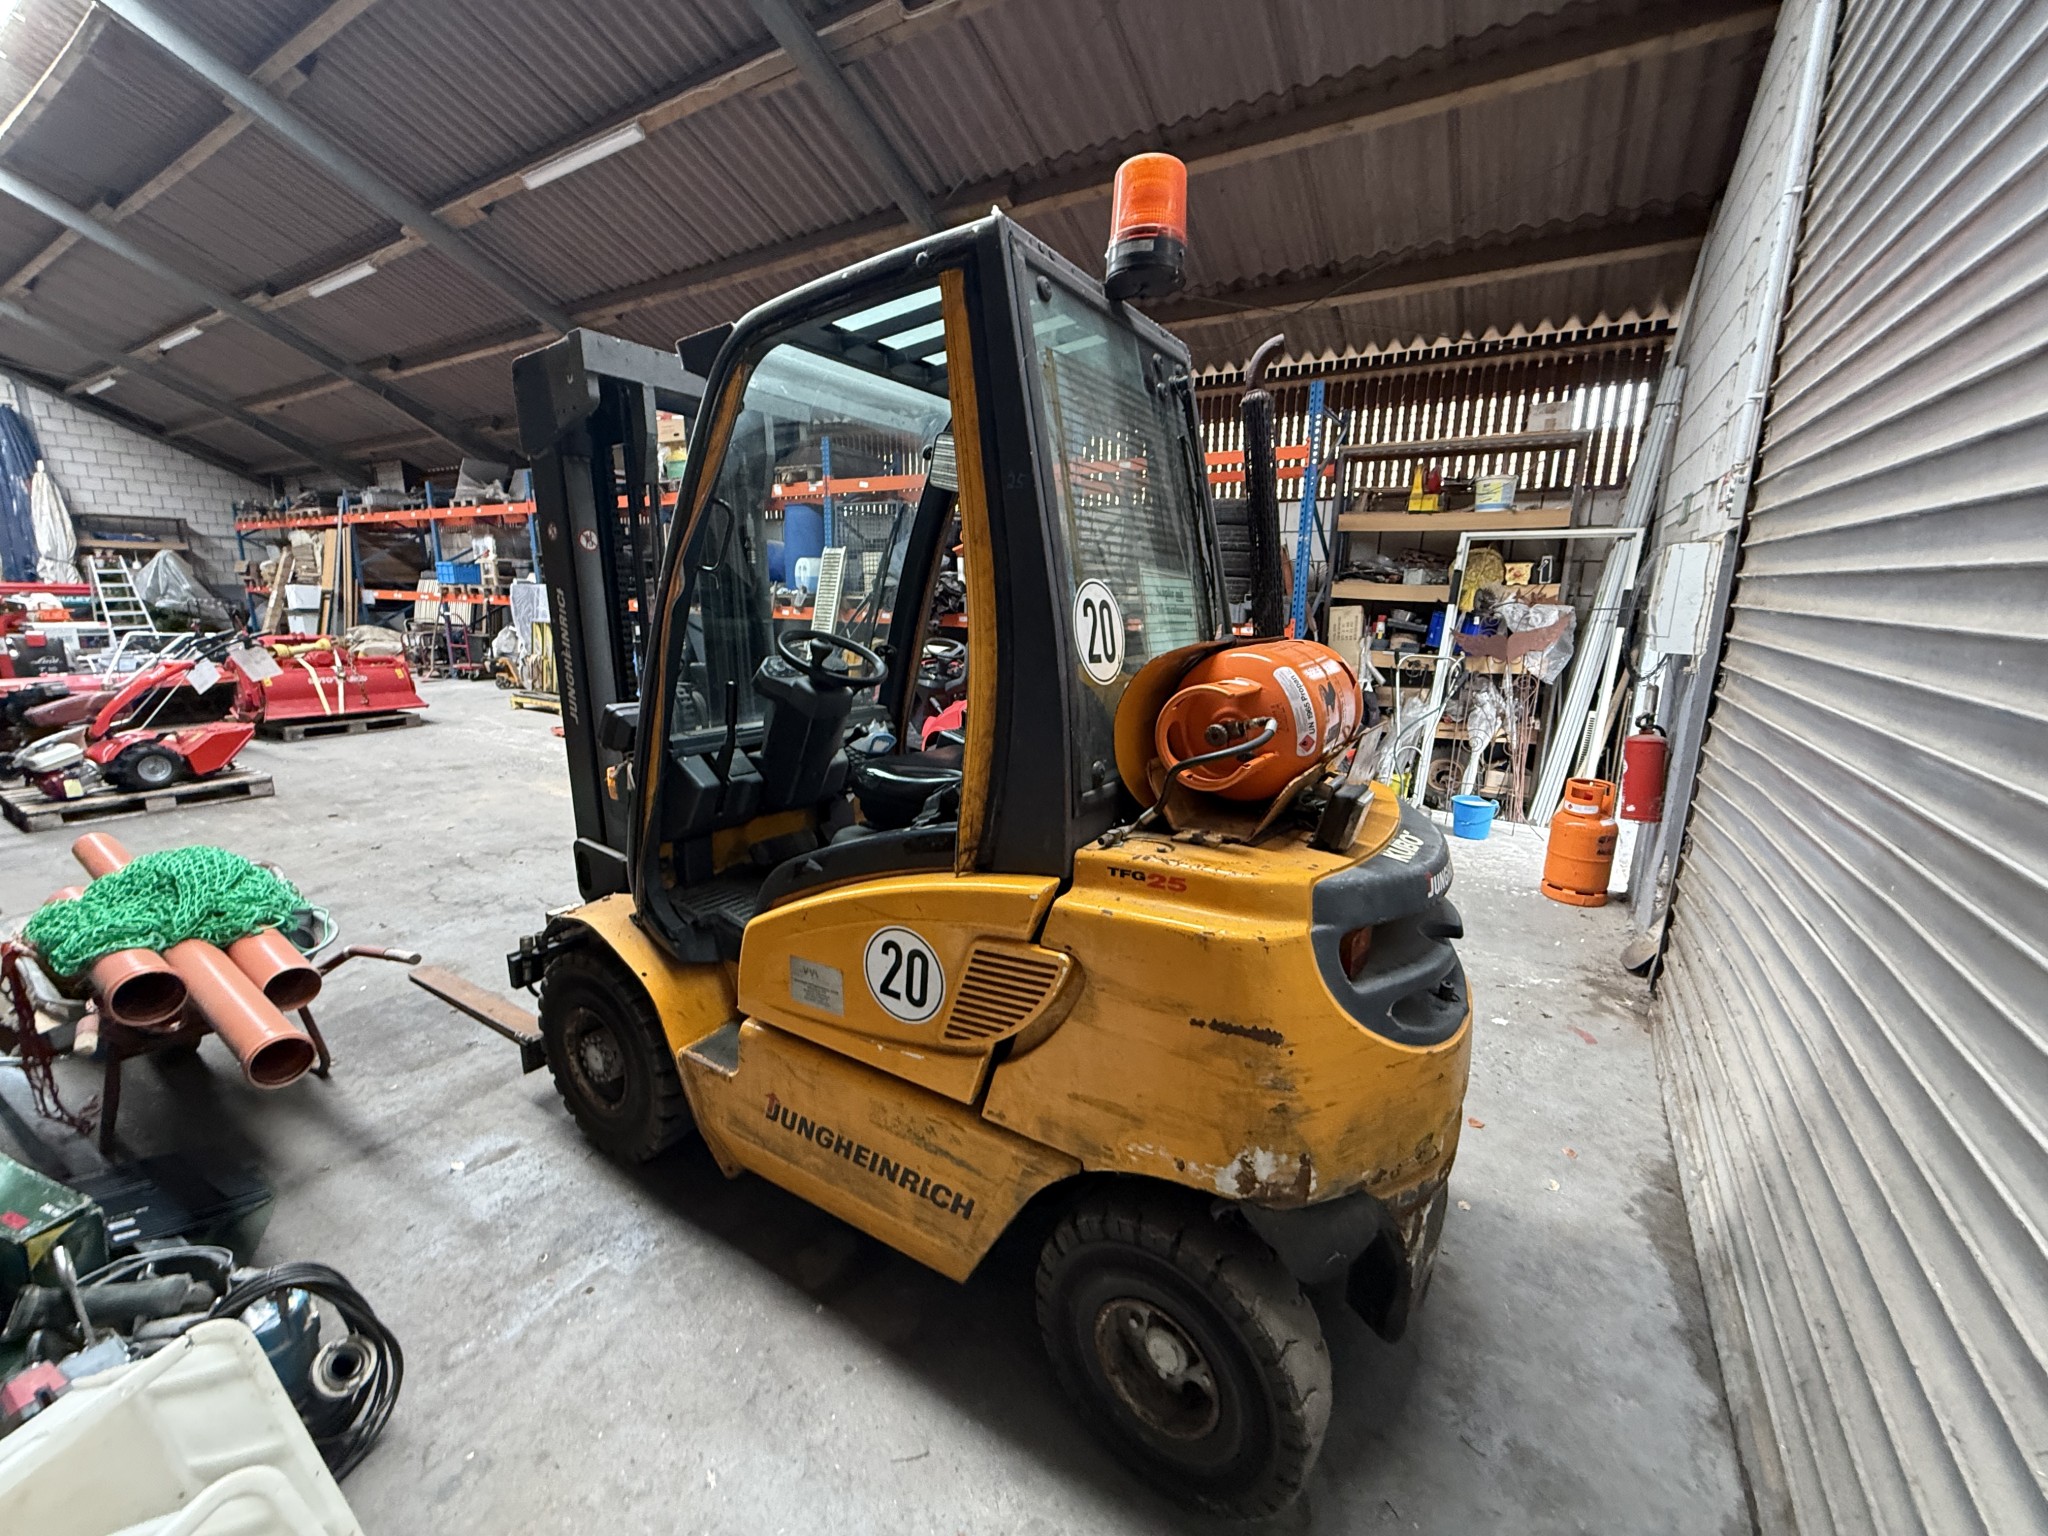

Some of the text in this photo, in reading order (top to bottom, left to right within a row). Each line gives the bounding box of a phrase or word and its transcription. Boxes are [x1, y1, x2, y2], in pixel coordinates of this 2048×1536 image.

[1083, 597, 1117, 664] 20
[1290, 674, 1308, 702] Propan
[1308, 721, 1316, 735] UN
[880, 940, 929, 1008] 20
[766, 1099, 975, 1220] JUNGHEINRICH
